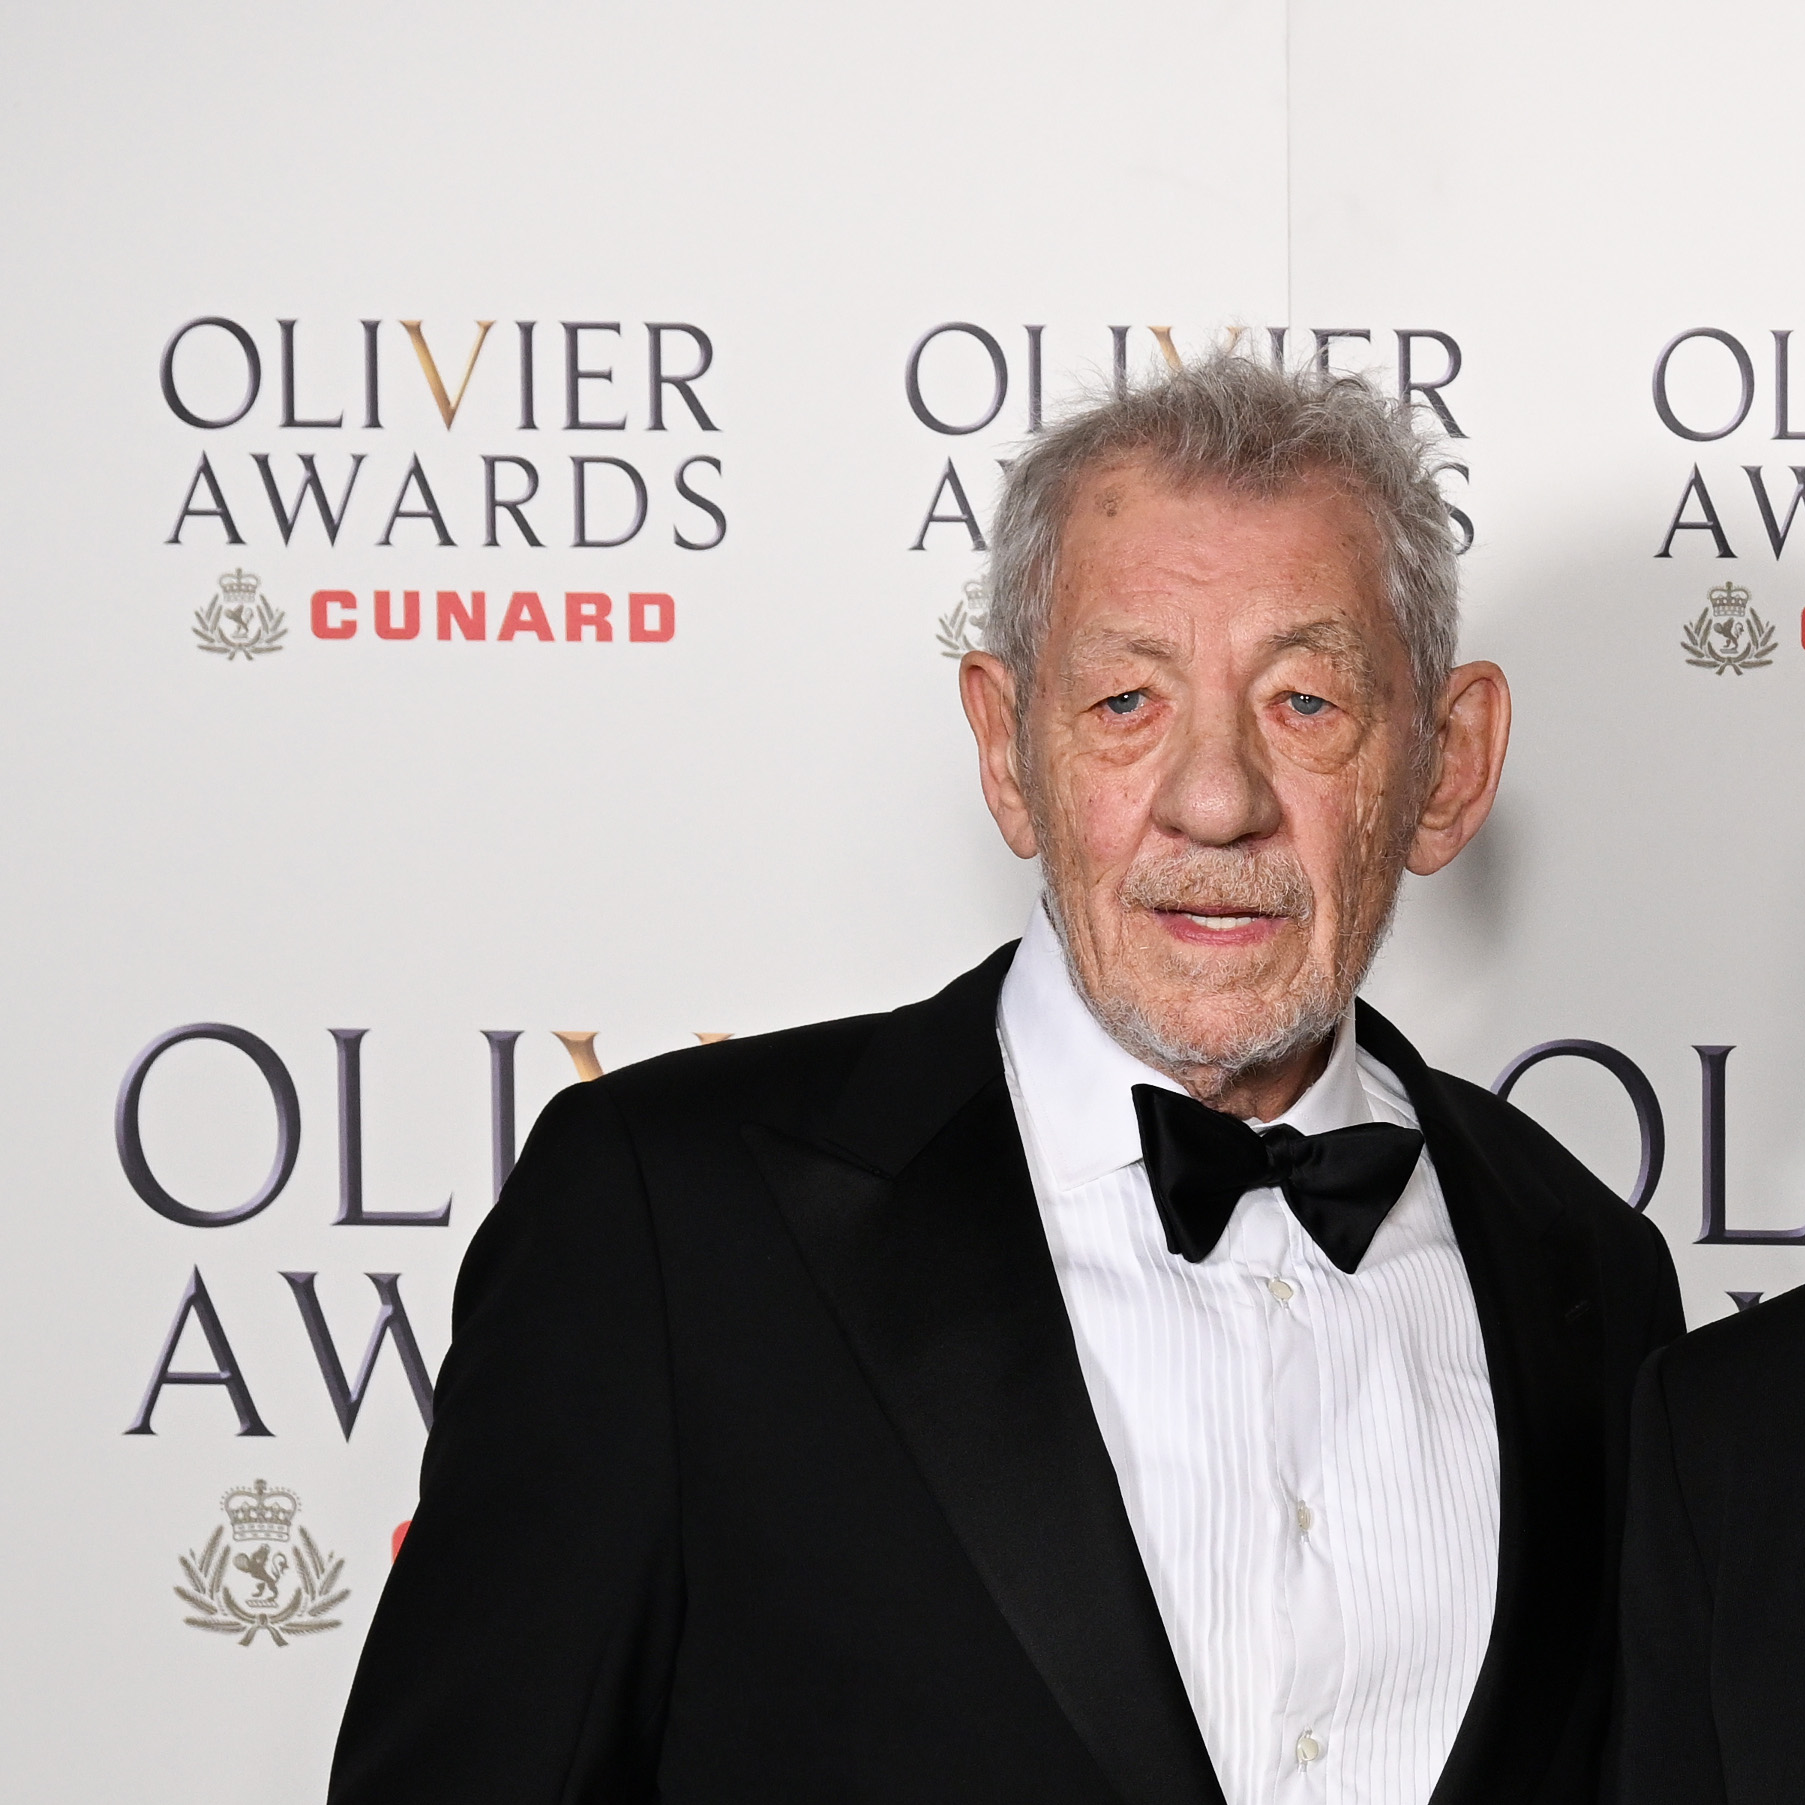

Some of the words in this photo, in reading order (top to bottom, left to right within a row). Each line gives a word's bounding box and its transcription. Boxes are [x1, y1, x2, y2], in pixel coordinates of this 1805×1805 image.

[160, 316, 721, 432] OLIVIER
[163, 450, 728, 552] AWARDS
[310, 589, 676, 643] CUNARD
